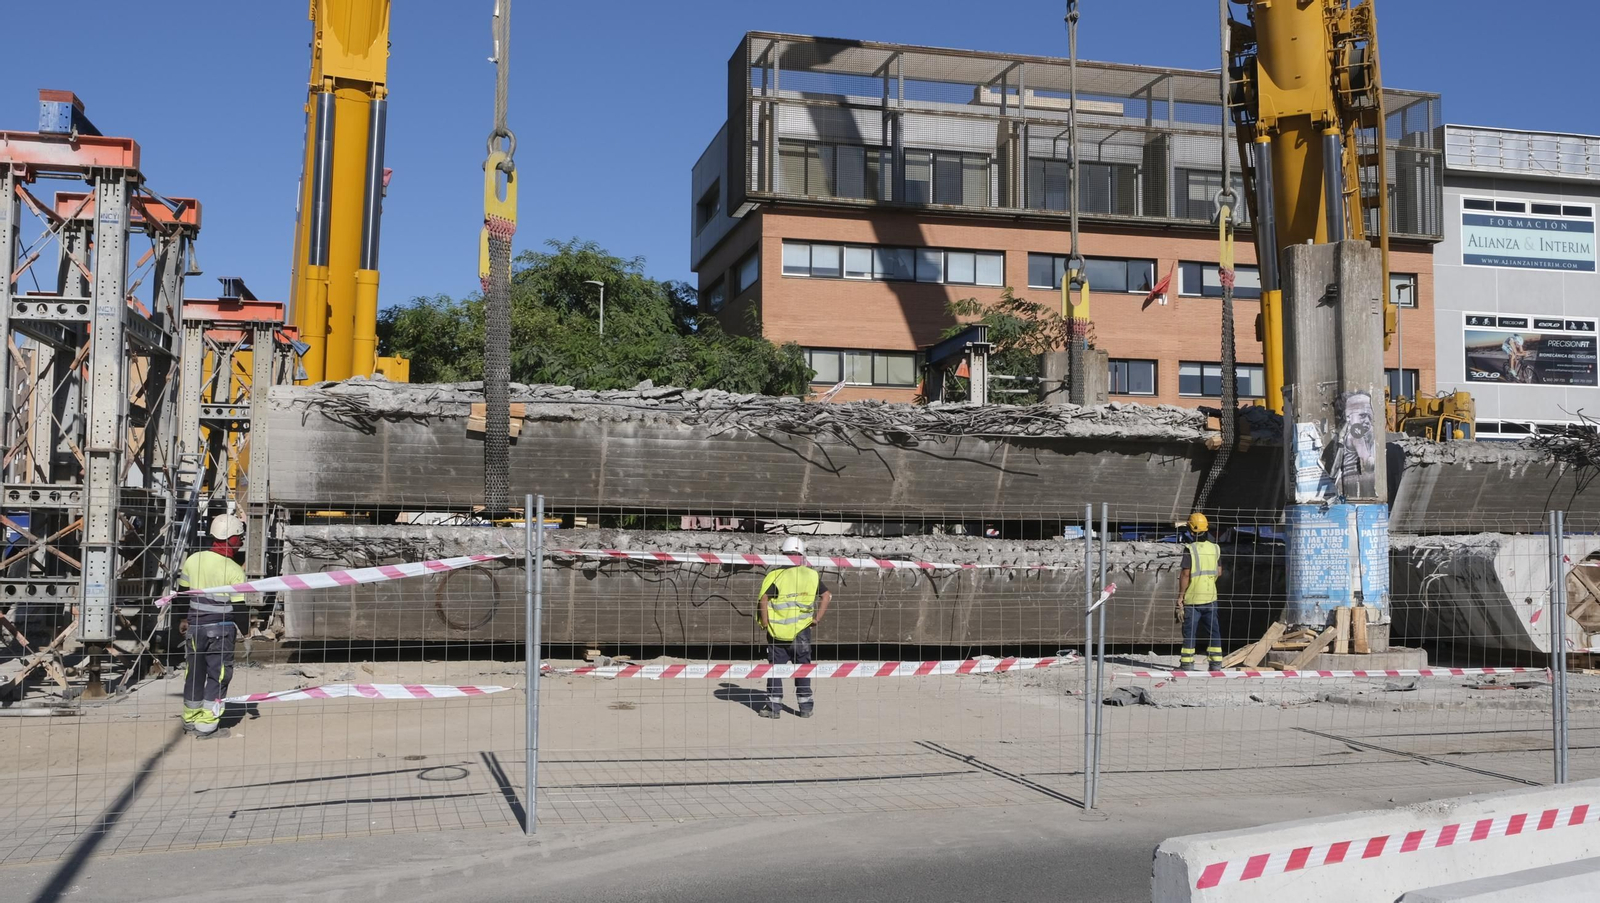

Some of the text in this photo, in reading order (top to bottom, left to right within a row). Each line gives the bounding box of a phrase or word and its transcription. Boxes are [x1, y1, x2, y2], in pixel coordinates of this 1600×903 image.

[1489, 218, 1568, 230] FORMACIÓN
[1524, 236, 1535, 251] &
[1547, 339, 1590, 348] PRECISIONFIT
